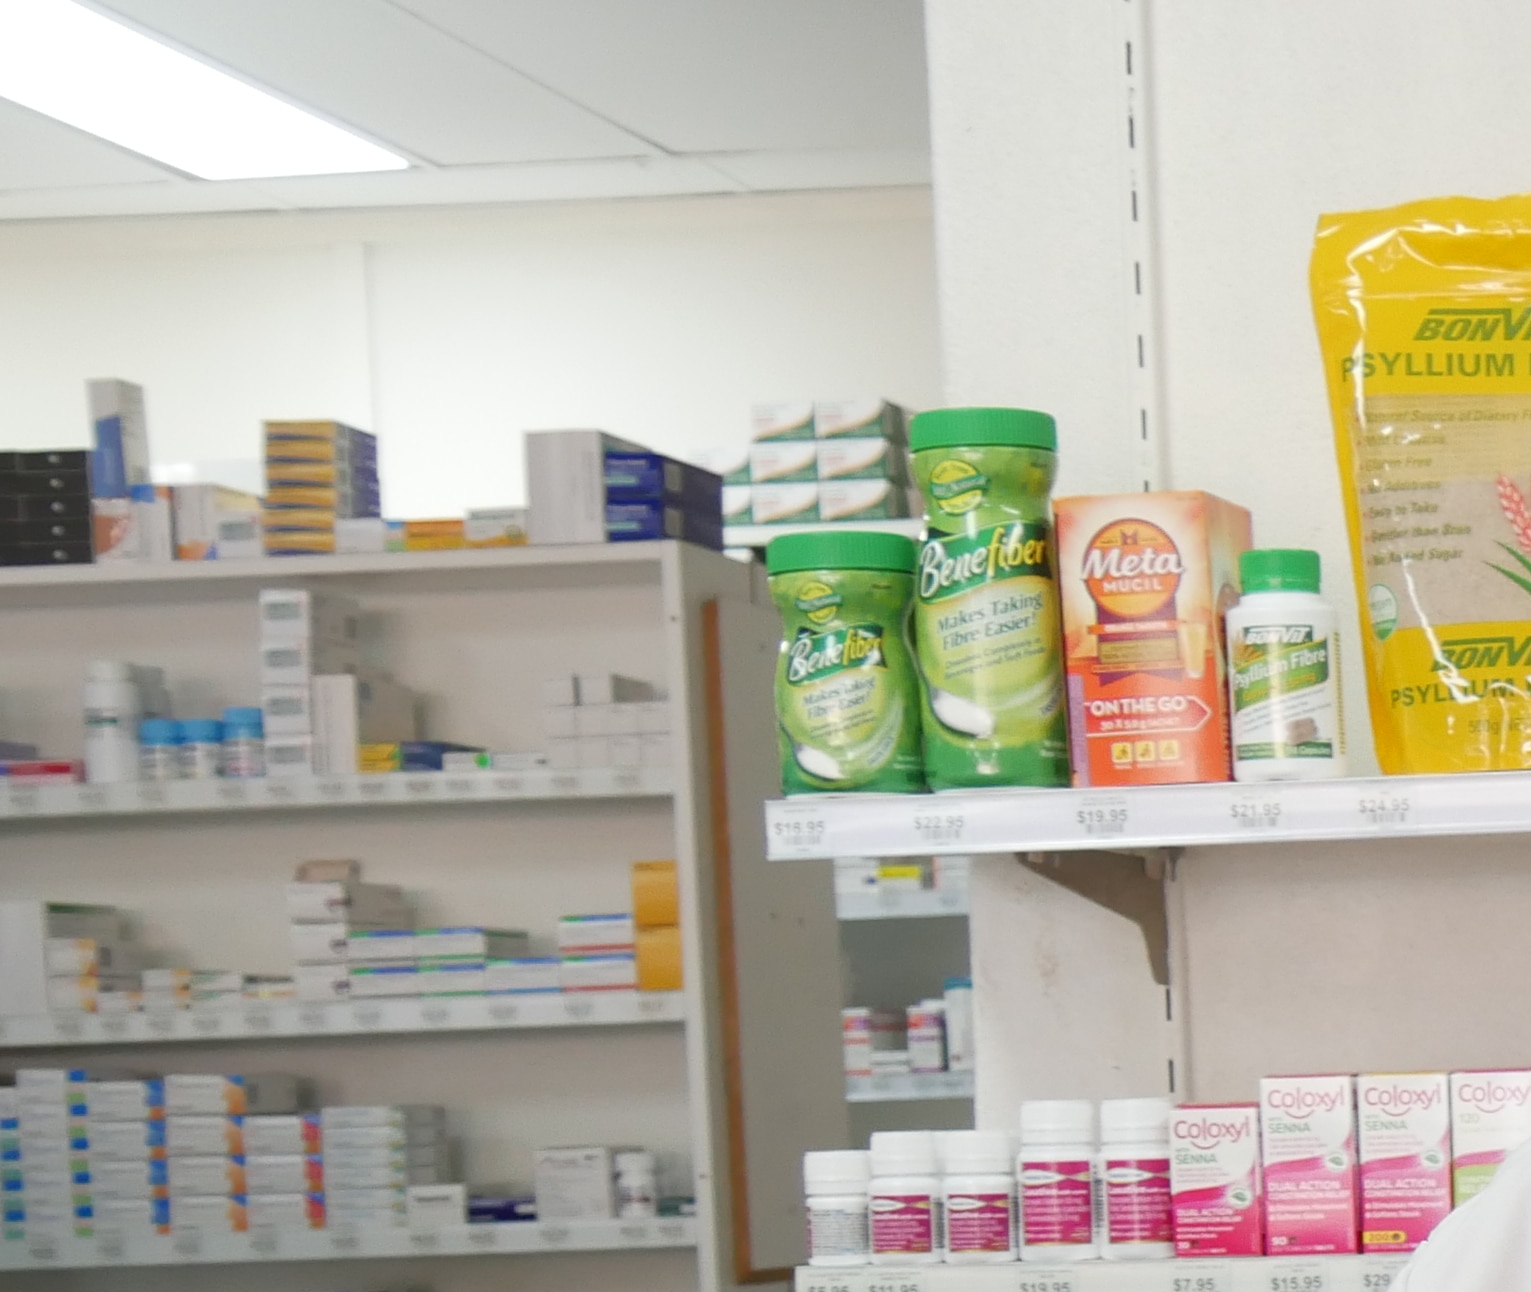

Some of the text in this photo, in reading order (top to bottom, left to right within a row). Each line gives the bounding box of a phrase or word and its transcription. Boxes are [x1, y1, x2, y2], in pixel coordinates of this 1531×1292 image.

[1342, 352, 1515, 382] PSYLLIUM
[920, 523, 1046, 598] Benefiber
[1080, 548, 1187, 580] Meta
[1103, 577, 1163, 592] MUCIL
[937, 592, 1044, 634] Makes Taking
[943, 629, 980, 651] Fibre
[788, 629, 883, 683] Benefiber
[1291, 647, 1326, 668] Fibre
[803, 684, 840, 705] Makes
[1090, 696, 1188, 716] ON THE GO
[1268, 1086, 1345, 1112] Coloxyl
[1364, 1083, 1442, 1110] Coloxyl
[1173, 1115, 1250, 1143] Coloxyl
[1268, 1122, 1311, 1134] SENNA
[1364, 1120, 1408, 1132] SENNA
[1175, 1153, 1218, 1165] SENNA
[1173, 1278, 1215, 1292] $7.95
[1270, 1275, 1323, 1291] $15.95
[1363, 1273, 1392, 1288] $29
